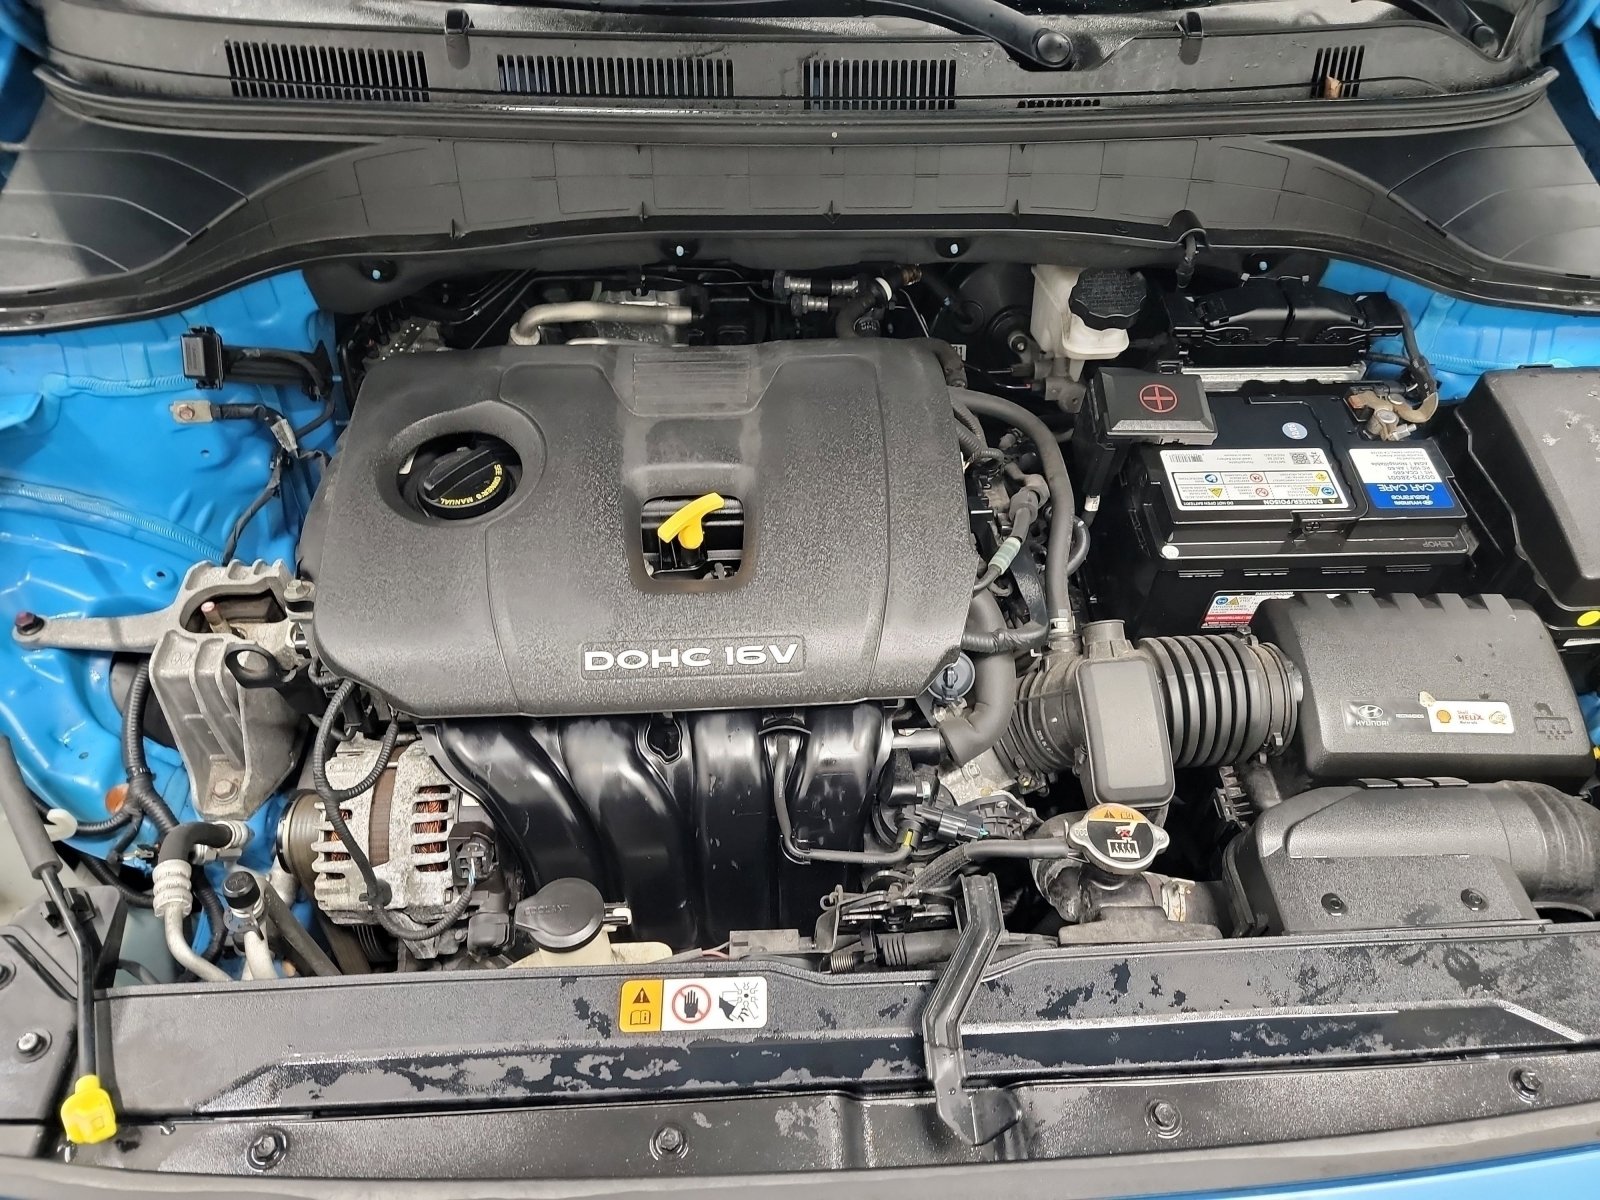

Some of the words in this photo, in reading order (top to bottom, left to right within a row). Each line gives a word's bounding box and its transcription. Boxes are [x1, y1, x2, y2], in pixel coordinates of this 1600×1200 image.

[494, 464, 503, 475] SEE
[476, 476, 501, 500] OWNER'S
[440, 496, 474, 505] MANUAL
[584, 648, 712, 671] DOHC
[724, 643, 798, 666] 16V
[1458, 712, 1485, 720] HELIX
[1355, 719, 1390, 727] HYUNDAI
